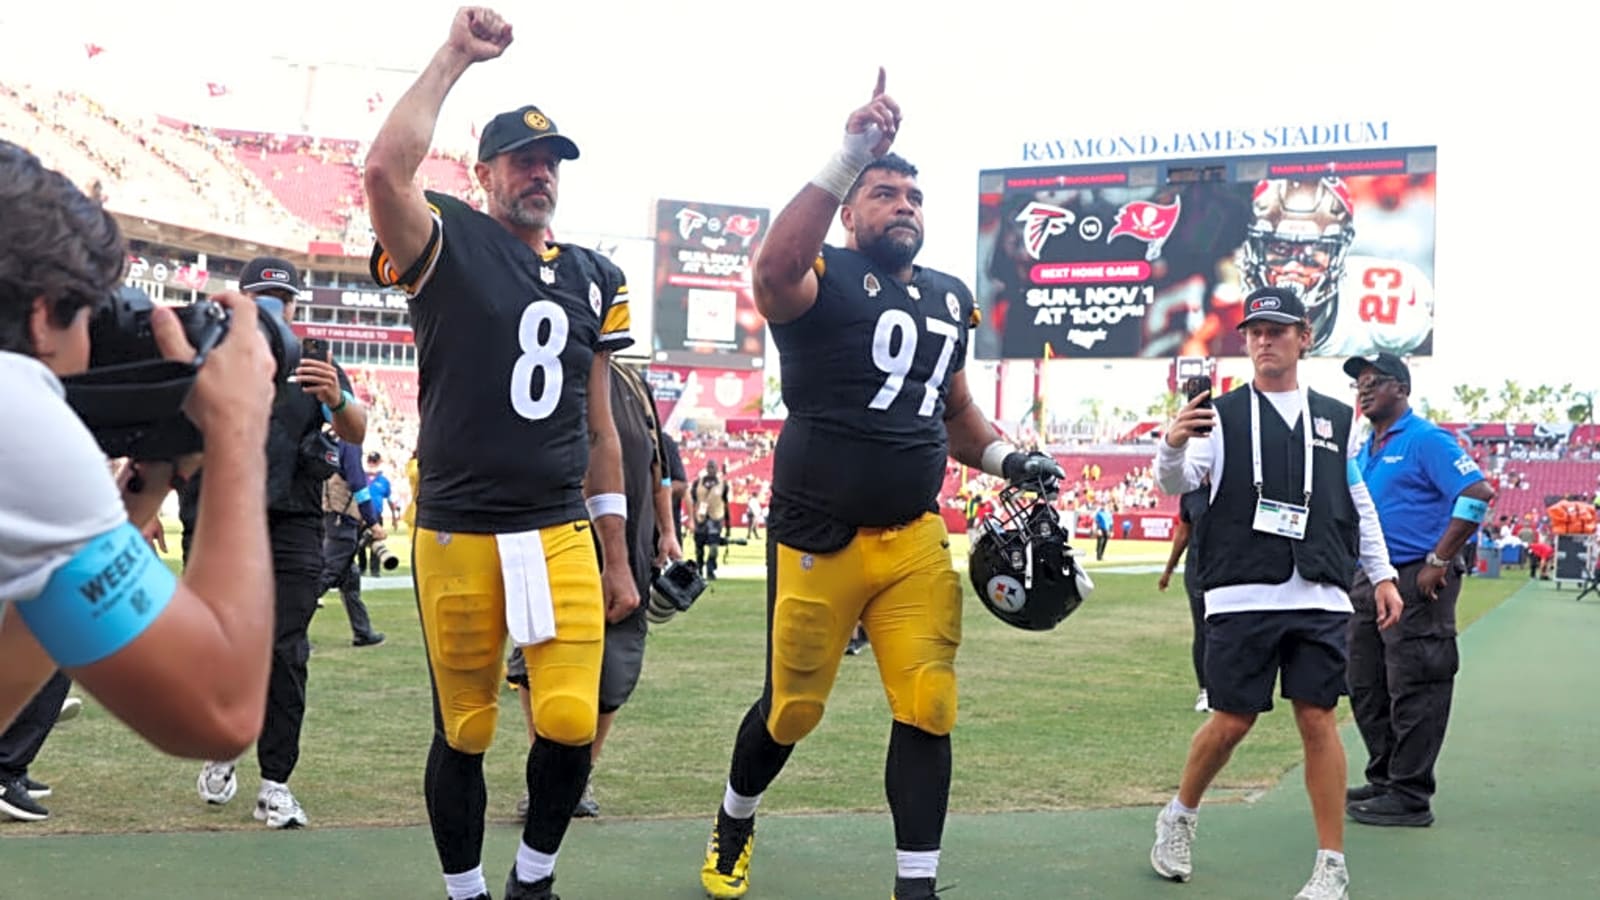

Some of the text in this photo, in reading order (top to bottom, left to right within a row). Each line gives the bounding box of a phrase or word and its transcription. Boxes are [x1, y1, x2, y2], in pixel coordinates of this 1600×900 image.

[1022, 121, 1389, 161] RAYMOND JAMES STADIUM
[1040, 266, 1139, 279] NEXT HOME GAME
[1026, 286, 1154, 307] SUN. NOV 1
[1034, 306, 1067, 326] AT
[1358, 267, 1403, 325] 23
[306, 327, 327, 337] TEXT
[328, 328, 345, 338] FAN
[376, 331, 388, 341] TO
[510, 299, 570, 421] 8
[867, 308, 959, 418] 97
[79, 549, 137, 604] WEEK
